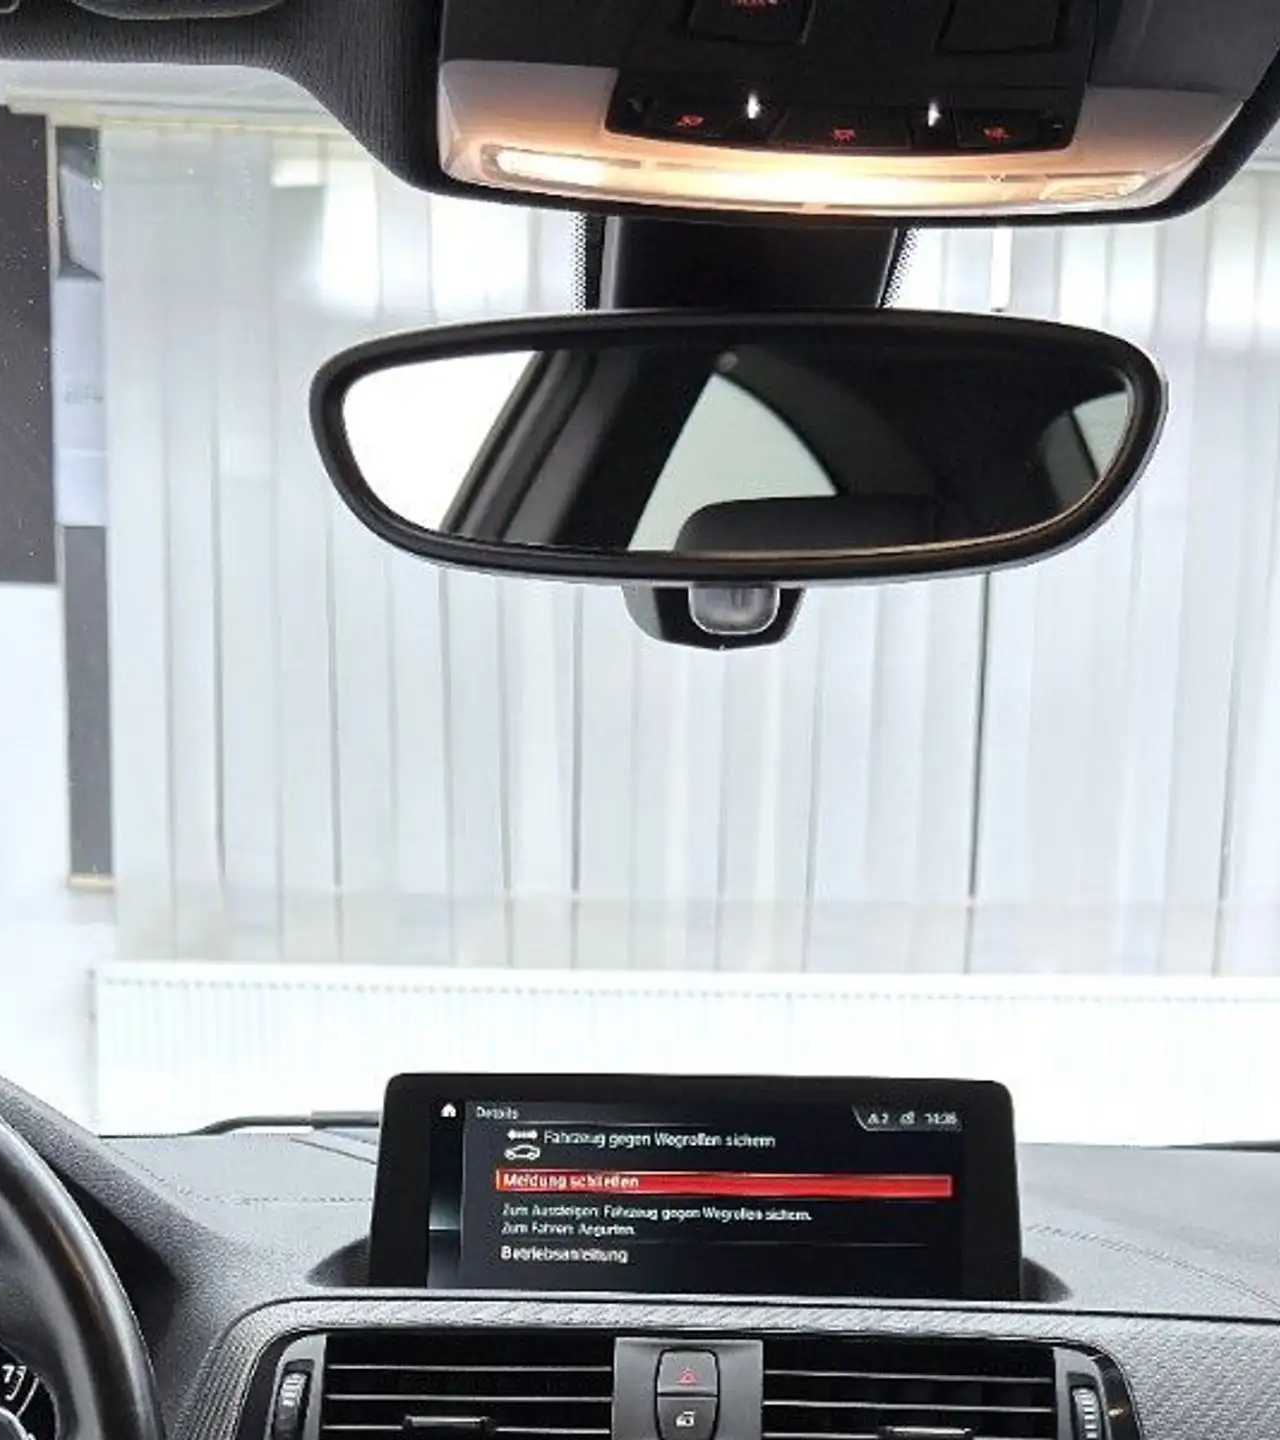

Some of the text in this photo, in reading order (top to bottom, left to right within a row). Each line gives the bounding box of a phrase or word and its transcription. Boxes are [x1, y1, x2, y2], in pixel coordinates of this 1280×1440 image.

[476, 1106, 519, 1120] Details
[543, 1129, 776, 1149] Fahrzeug gegen Wegrollen sichern
[503, 1173, 567, 1190] Meldung
[502, 1203, 529, 1216] Zum
[603, 1205, 658, 1221] Fahrzeug
[661, 1207, 701, 1222] gegen
[703, 1206, 763, 1223] Wegrollen
[501, 1221, 528, 1235] Zum
[501, 1245, 629, 1264] Betriebsanleitung
